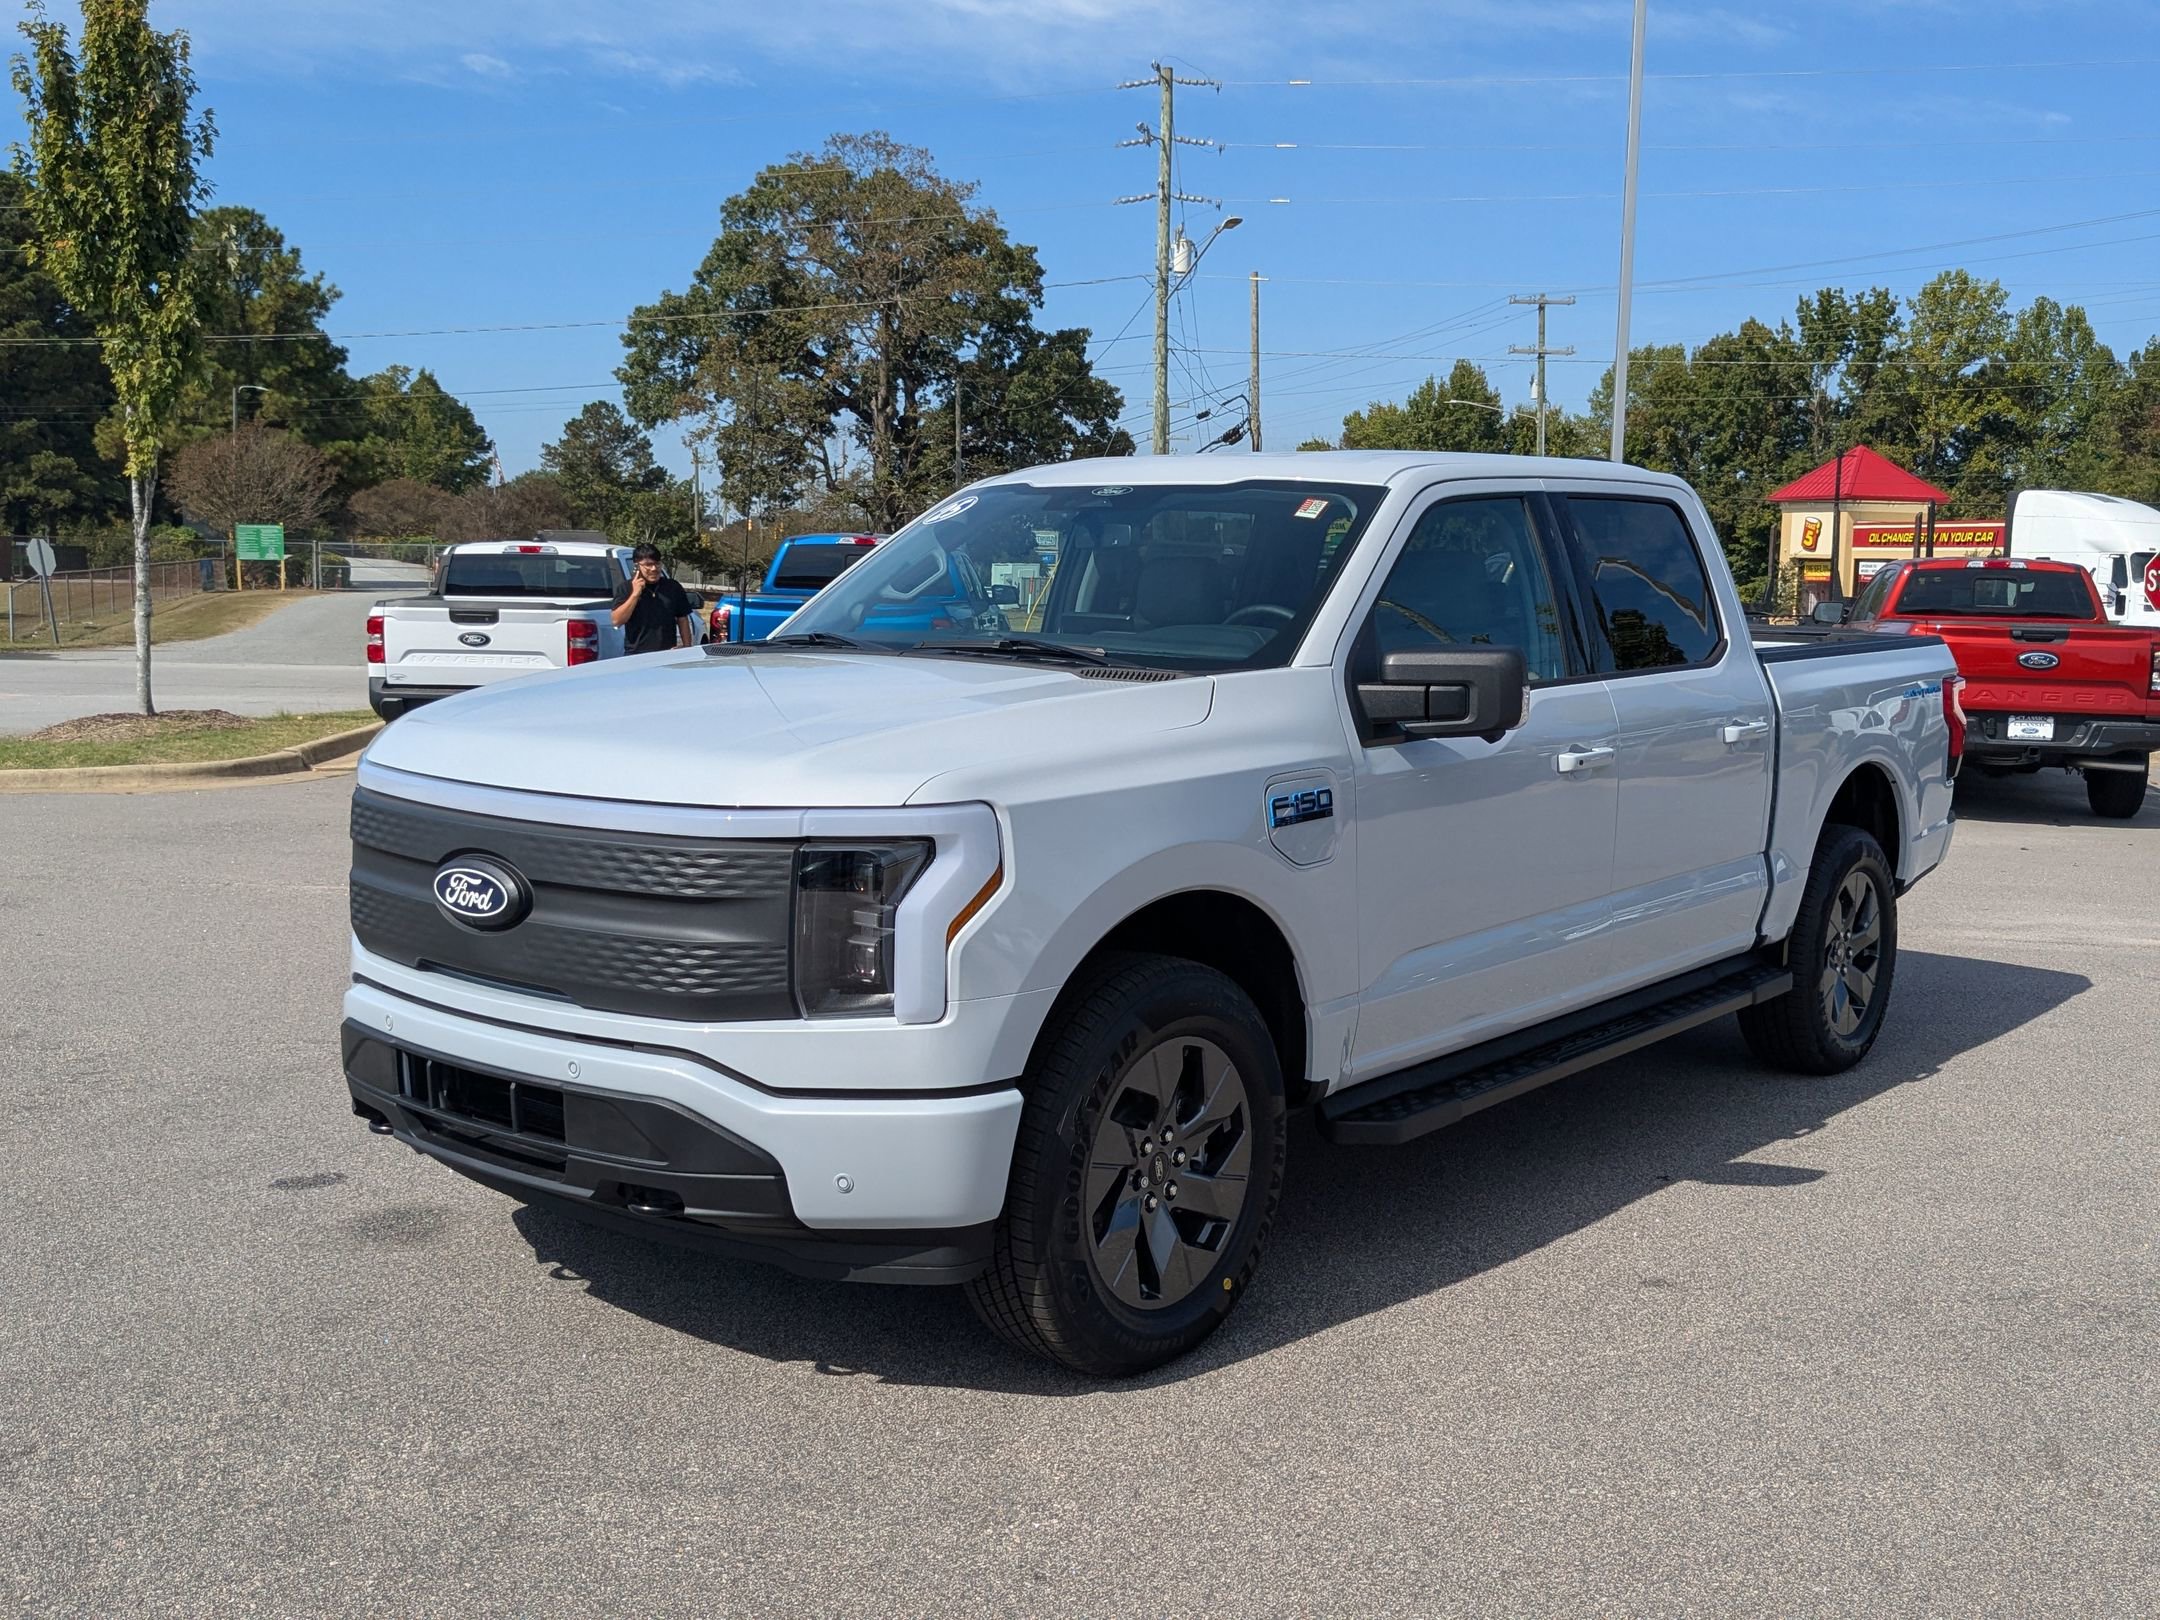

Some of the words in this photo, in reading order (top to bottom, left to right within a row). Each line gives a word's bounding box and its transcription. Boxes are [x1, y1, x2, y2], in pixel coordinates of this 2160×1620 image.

[1803, 530, 1814, 547] 5
[1868, 533, 1880, 543] OIL
[1881, 533, 1914, 543] CHANGE
[1940, 532, 1948, 543] IN
[1950, 532, 1973, 543] YOUR
[1974, 532, 1994, 542] CAR
[411, 655, 543, 665] MAVERICK
[2028, 655, 2050, 665] Ford
[1960, 690, 2128, 705] ANGER
[1270, 788, 1333, 823] F-150
[446, 873, 494, 911] Ford
